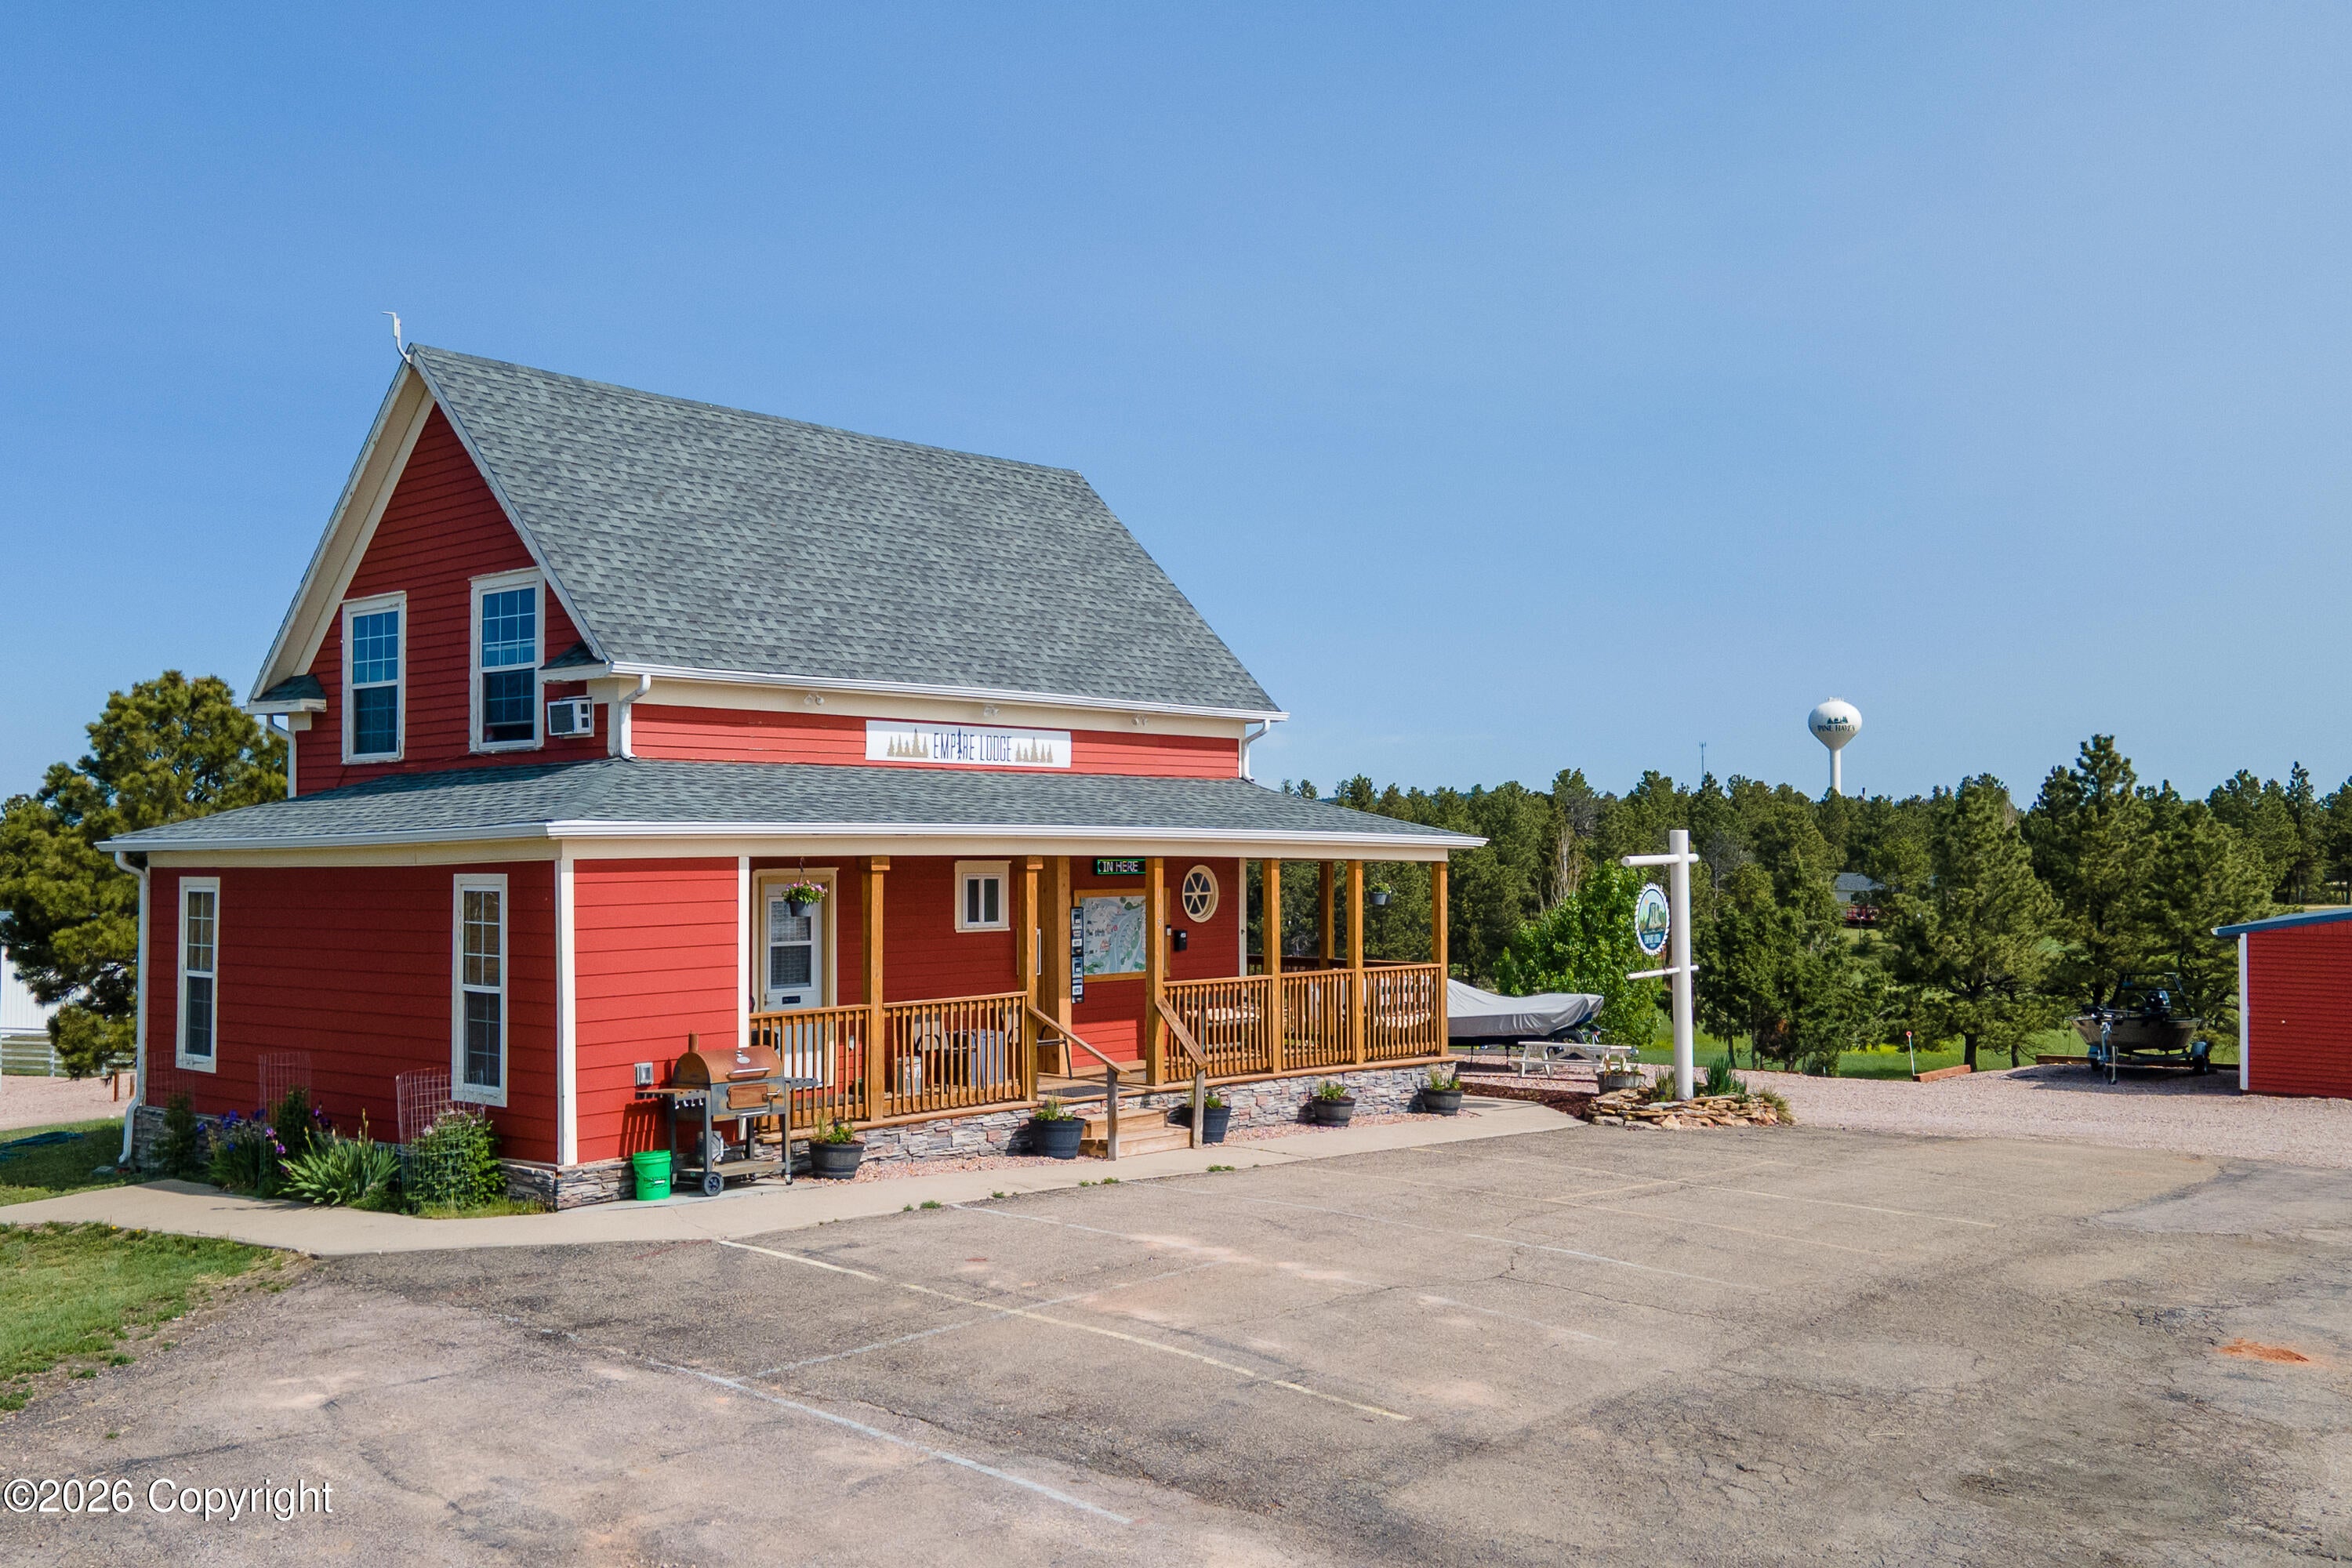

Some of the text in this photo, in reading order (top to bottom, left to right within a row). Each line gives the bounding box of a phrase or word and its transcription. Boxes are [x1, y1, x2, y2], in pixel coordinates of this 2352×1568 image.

[980, 735, 1012, 762] LODGE
[1102, 861, 1113, 872] IN
[1116, 861, 1138, 872] HERE
